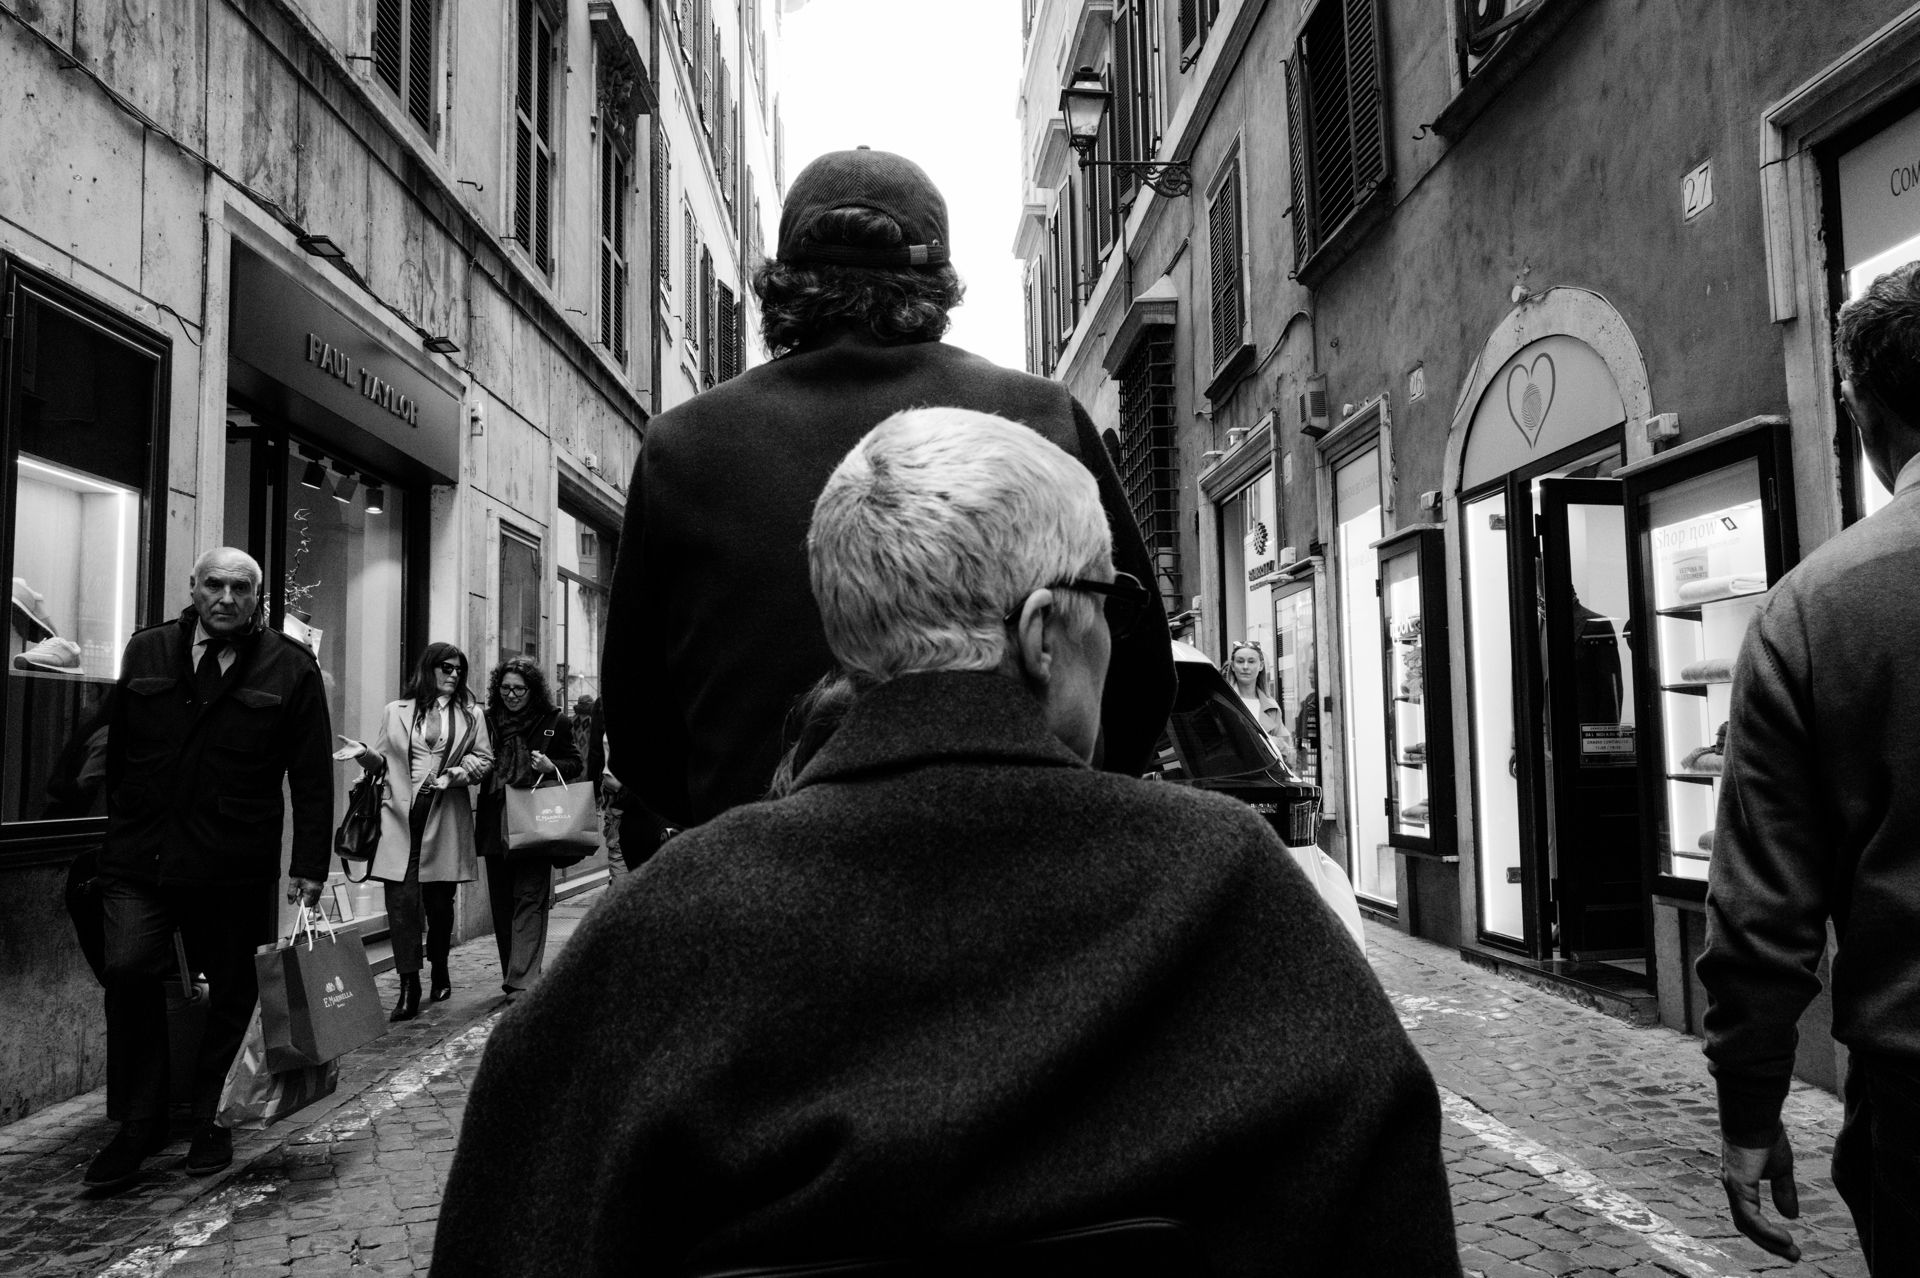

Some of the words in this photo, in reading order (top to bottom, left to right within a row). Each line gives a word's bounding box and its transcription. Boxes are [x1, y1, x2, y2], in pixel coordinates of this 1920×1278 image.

[1685, 166, 1709, 214] 27
[305, 333, 357, 388] PAUL
[359, 367, 418, 428] TAYLOR
[1411, 369, 1423, 397] 26
[1690, 520, 1718, 548] now
